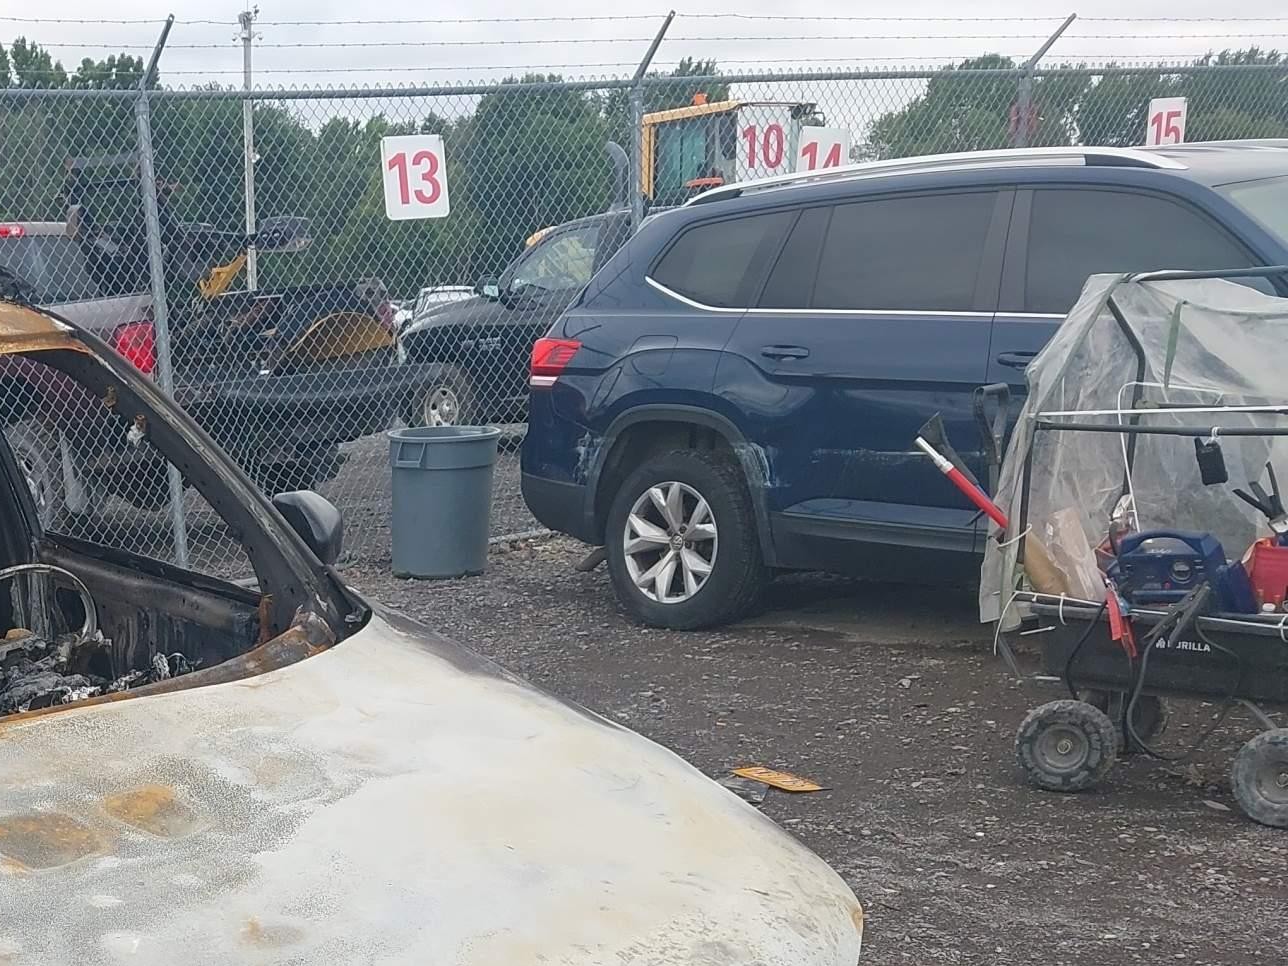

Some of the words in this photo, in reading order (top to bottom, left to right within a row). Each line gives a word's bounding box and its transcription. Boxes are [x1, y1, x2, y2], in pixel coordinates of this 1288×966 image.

[742, 123, 784, 169] 10
[1151, 110, 1182, 145] 15
[801, 141, 842, 171] 14
[388, 150, 441, 205] 13
